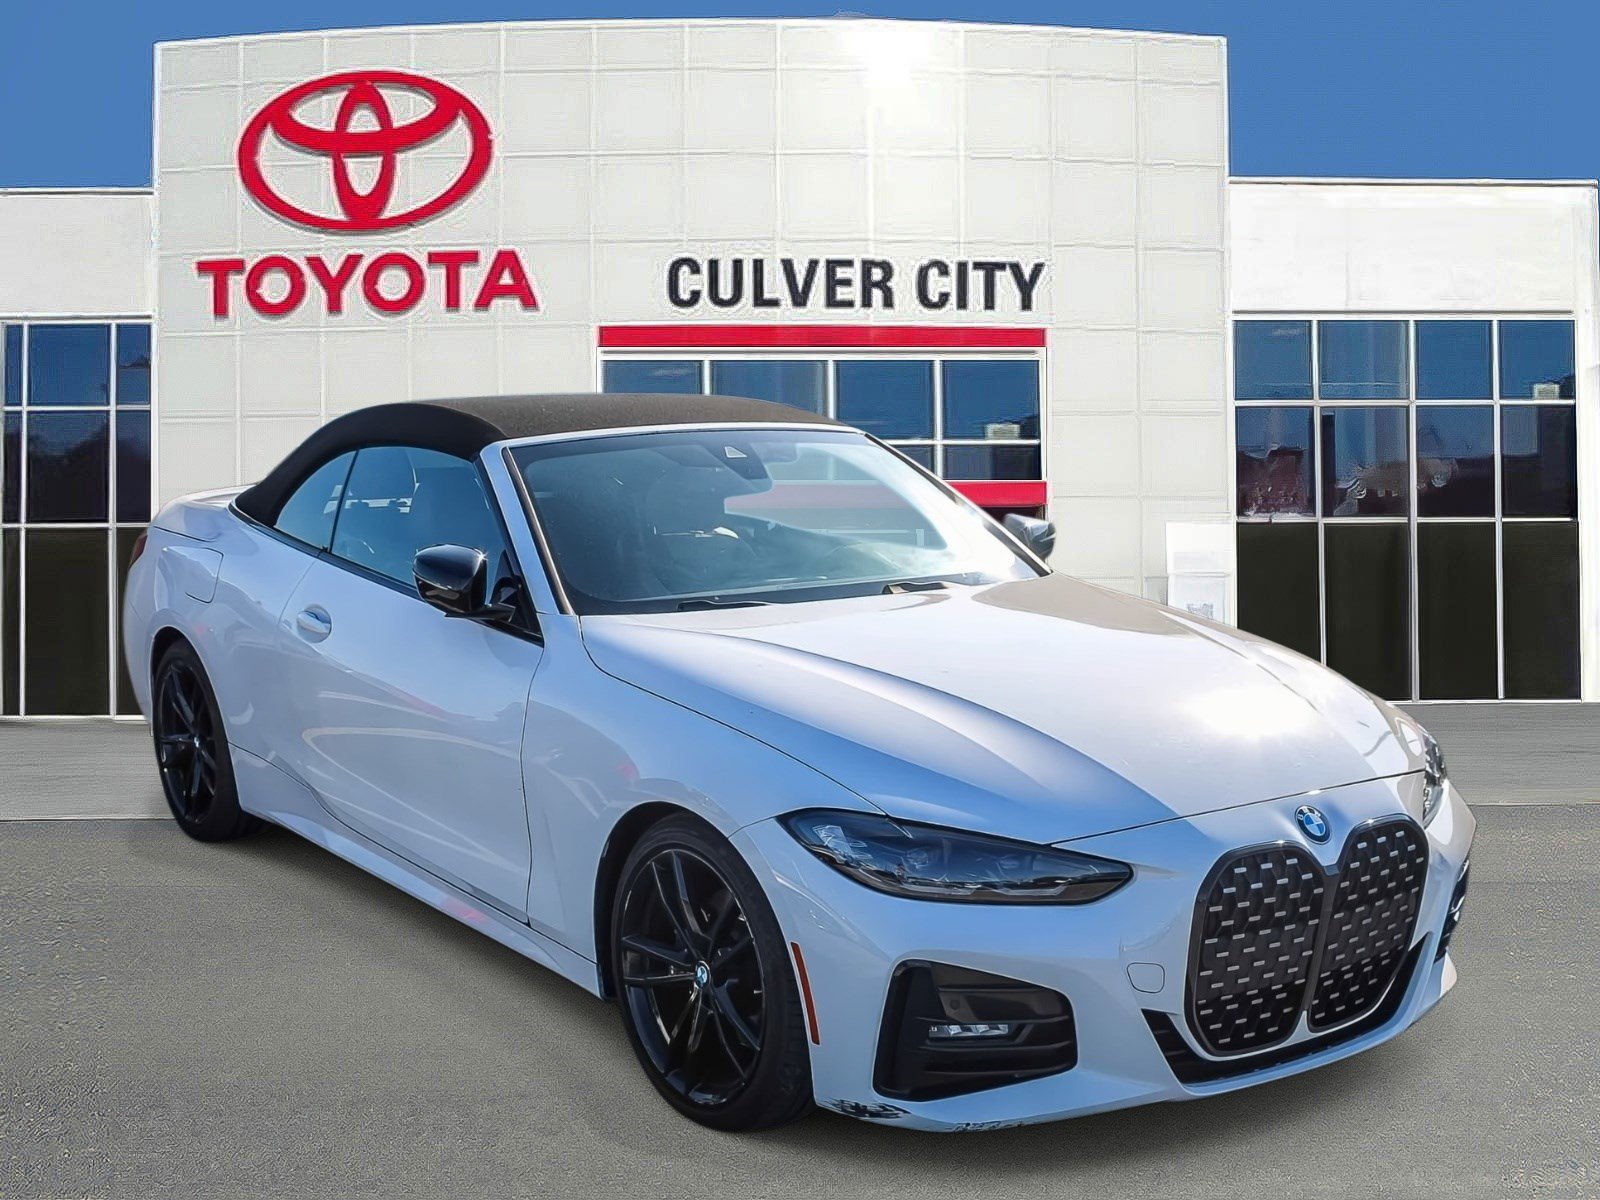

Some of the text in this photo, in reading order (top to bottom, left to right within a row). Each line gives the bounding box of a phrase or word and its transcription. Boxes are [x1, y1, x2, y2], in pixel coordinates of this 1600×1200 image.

[196, 249, 538, 318] TOYOTA
[667, 257, 1046, 311] CULVER CITY
